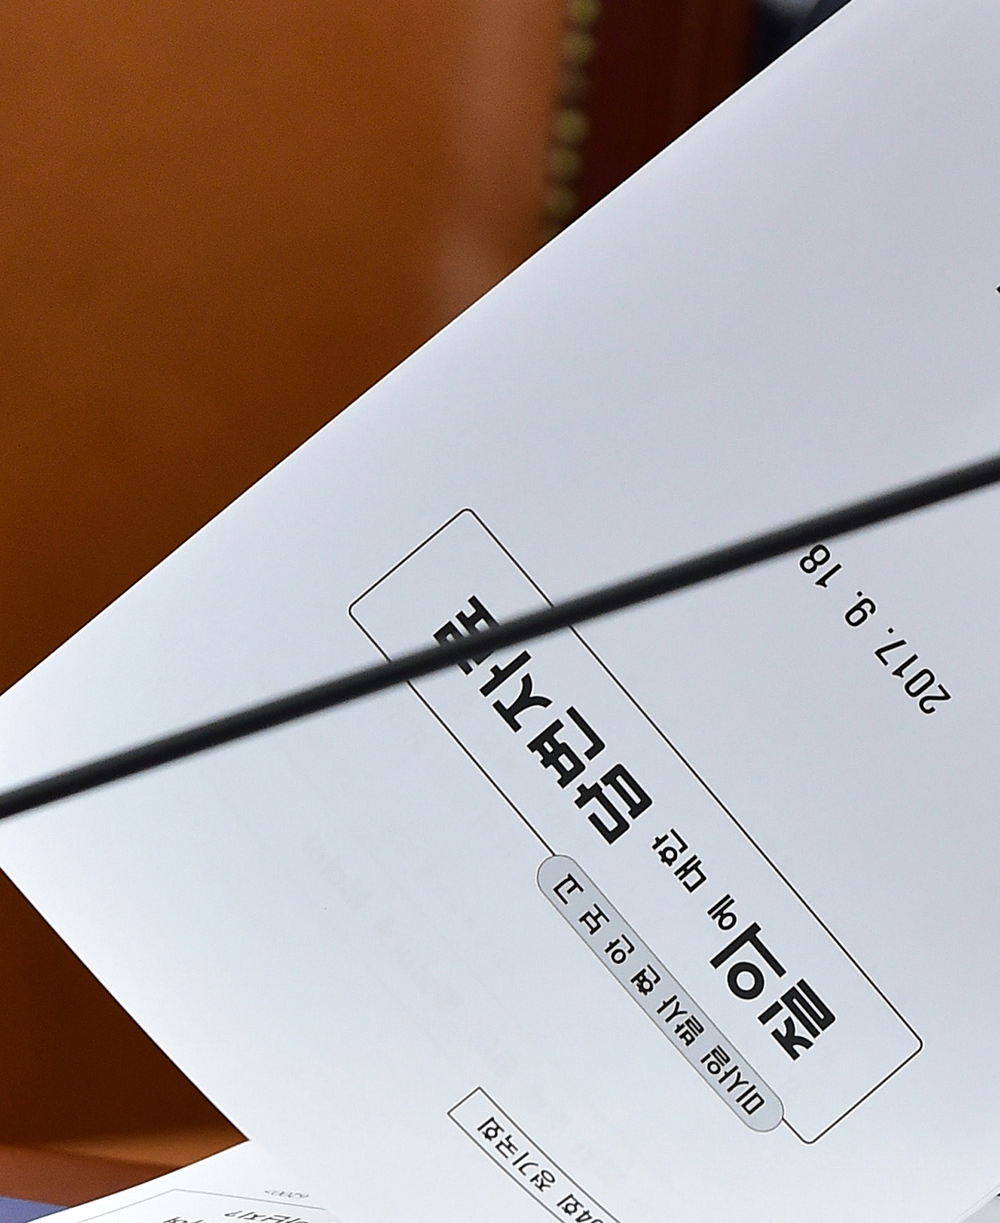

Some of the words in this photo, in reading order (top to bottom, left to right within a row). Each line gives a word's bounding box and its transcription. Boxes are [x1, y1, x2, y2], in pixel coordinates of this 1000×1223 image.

[844, 590, 876, 627] 9.
[874, 627, 952, 715] 2017.
[651, 828, 707, 894] 대한
[656, 994, 705, 1047] 발사
[700, 1044, 765, 1116] 미사일
[477, 1116, 556, 1192] 정기국회
